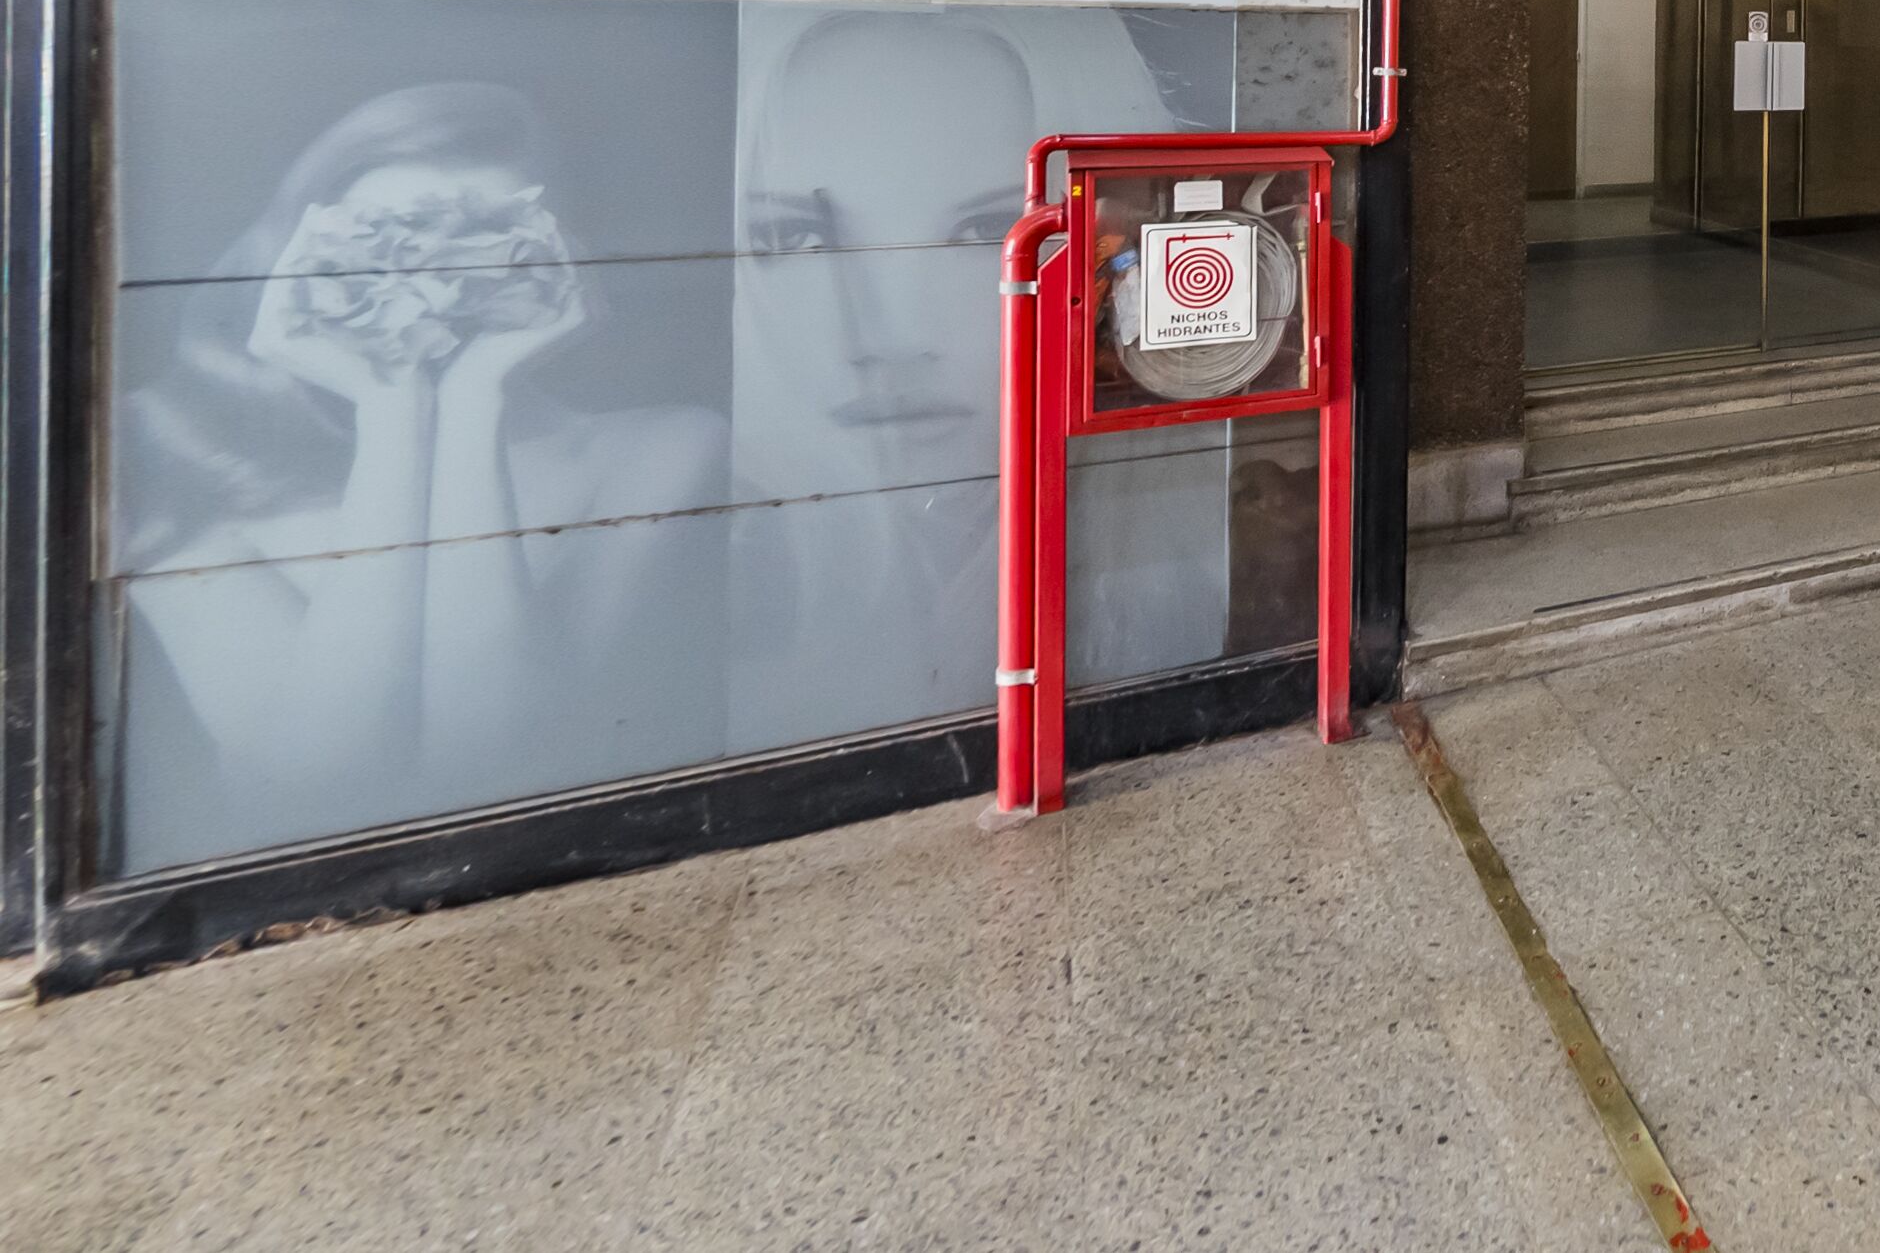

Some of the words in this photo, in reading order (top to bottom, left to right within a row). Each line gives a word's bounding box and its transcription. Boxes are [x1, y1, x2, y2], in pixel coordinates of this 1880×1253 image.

[1072, 185, 1082, 196] 2
[1170, 310, 1228, 324] NICHOS
[1157, 322, 1241, 338] HIDRANTES
